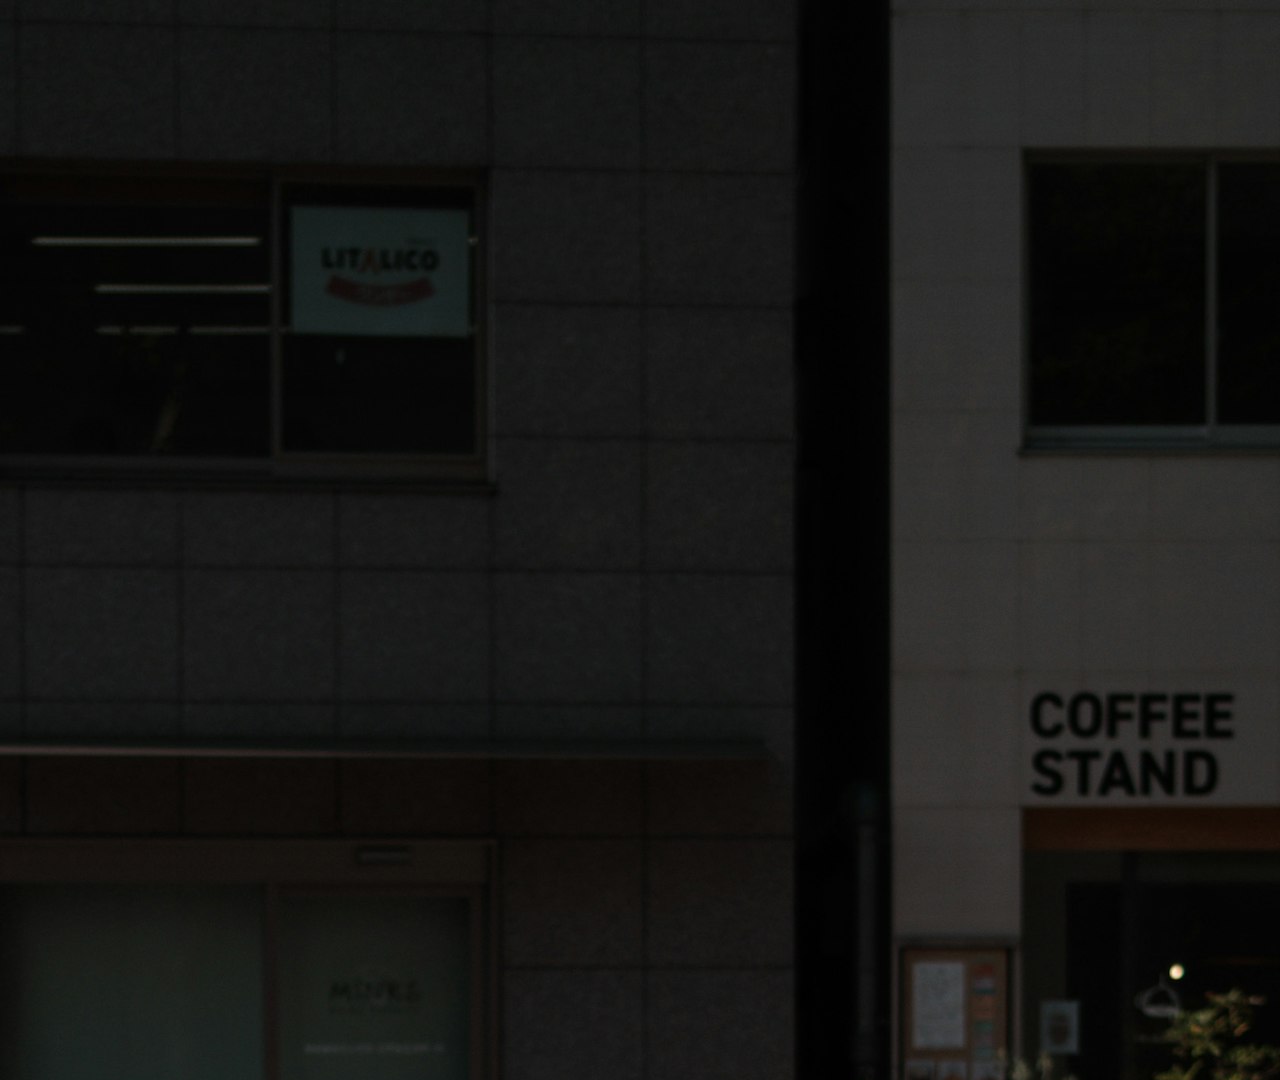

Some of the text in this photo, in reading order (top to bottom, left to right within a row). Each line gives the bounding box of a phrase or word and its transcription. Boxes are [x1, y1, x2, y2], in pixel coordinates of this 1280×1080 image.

[321, 247, 439, 273] LITALICO
[1030, 694, 1234, 739] COFFEE
[1031, 750, 1218, 796] STAND
